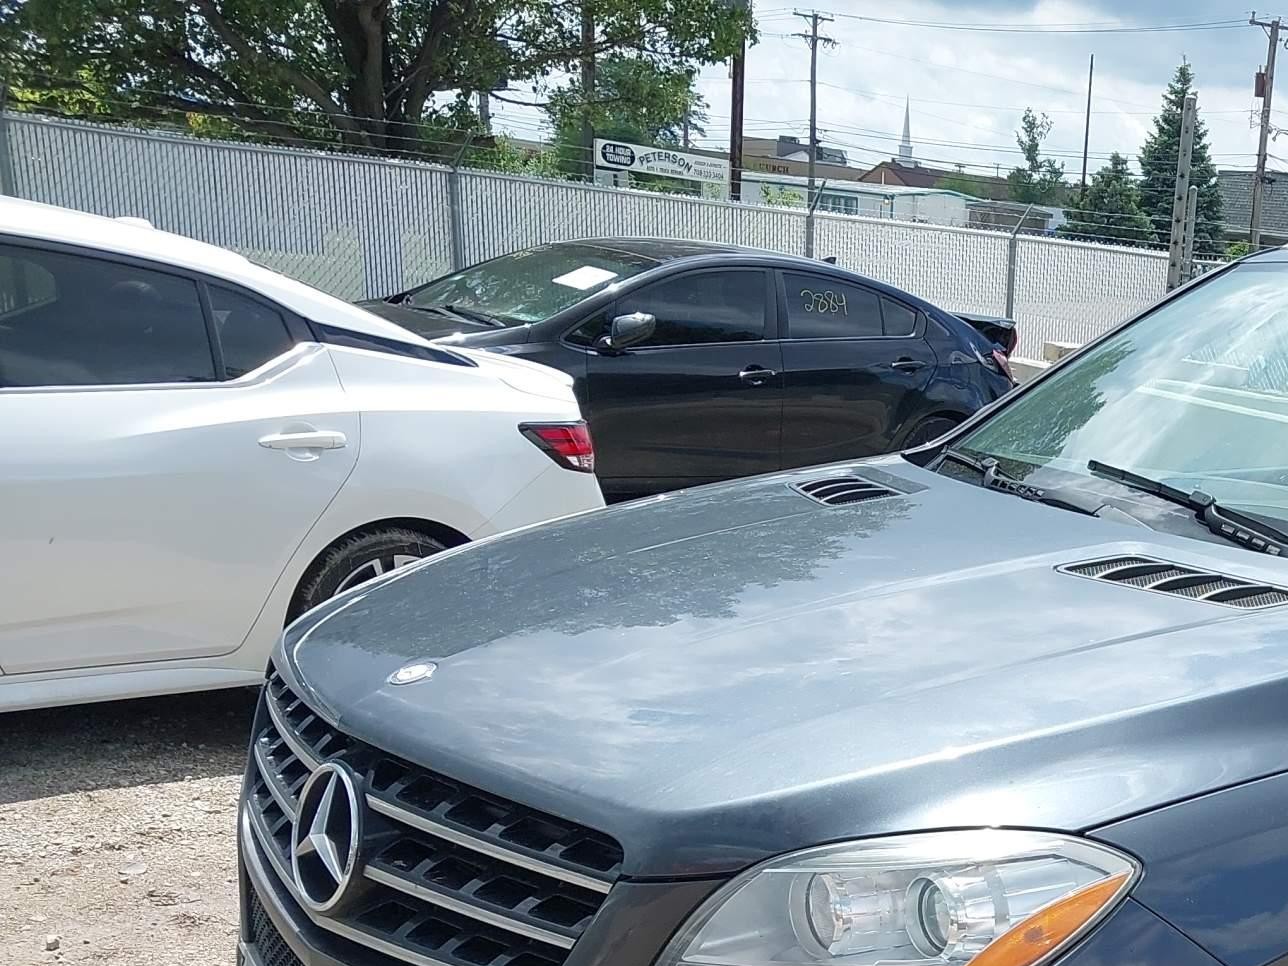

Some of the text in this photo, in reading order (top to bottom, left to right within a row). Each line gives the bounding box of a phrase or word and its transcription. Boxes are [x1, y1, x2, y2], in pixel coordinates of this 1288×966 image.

[605, 144, 632, 156] 24 HOUR
[606, 153, 632, 165] TOWING
[638, 151, 693, 173] PETERSON
[800, 289, 849, 316] 2884
